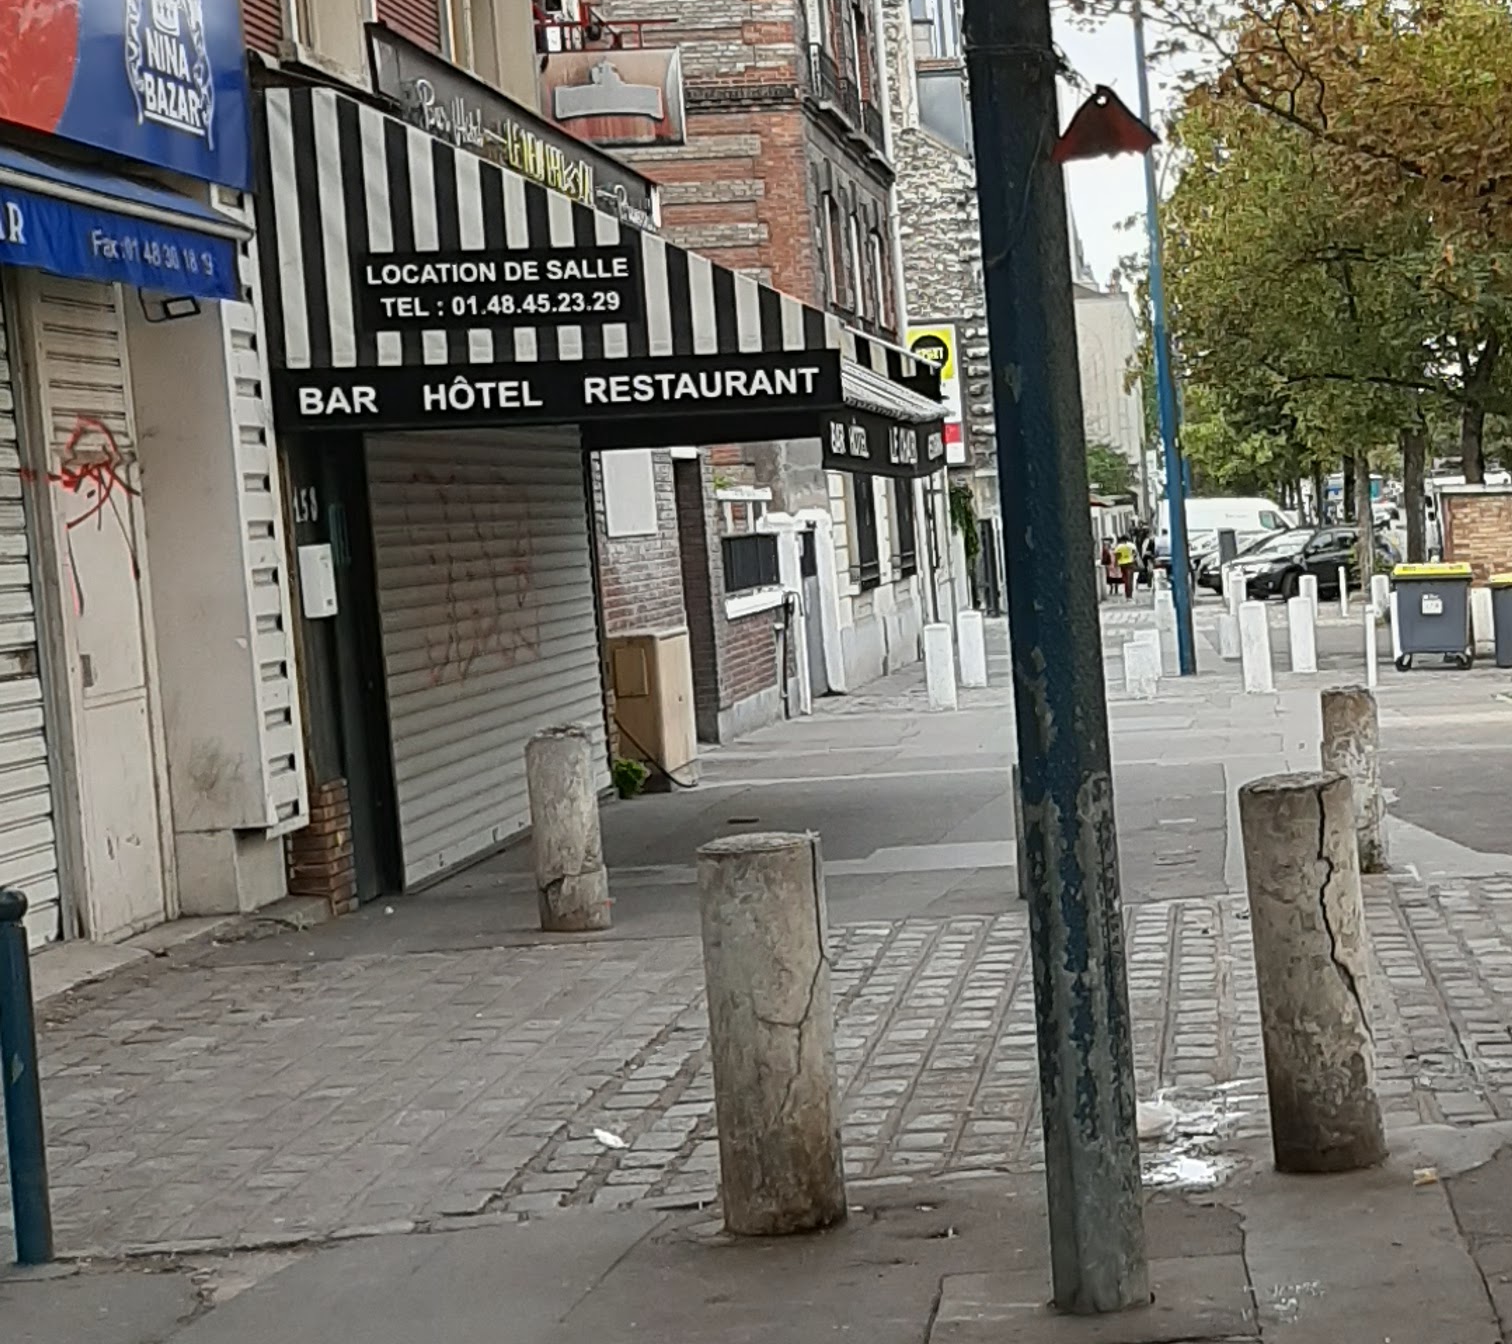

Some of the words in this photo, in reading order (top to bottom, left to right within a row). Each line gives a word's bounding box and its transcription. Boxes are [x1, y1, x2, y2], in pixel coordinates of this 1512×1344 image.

[145, 26, 191, 83] NINA
[143, 71, 202, 128] BAZAR
[144, 240, 161, 267] 48
[366, 262, 496, 285] LOCATION
[504, 261, 539, 281] DE
[546, 258, 629, 280] SALLE
[380, 297, 430, 317] TEL
[452, 291, 621, 316] 01.48.45.23.29
[299, 386, 379, 415] BAR
[423, 375, 543, 410] HÔTEL
[584, 367, 820, 404] RESTAURANT
